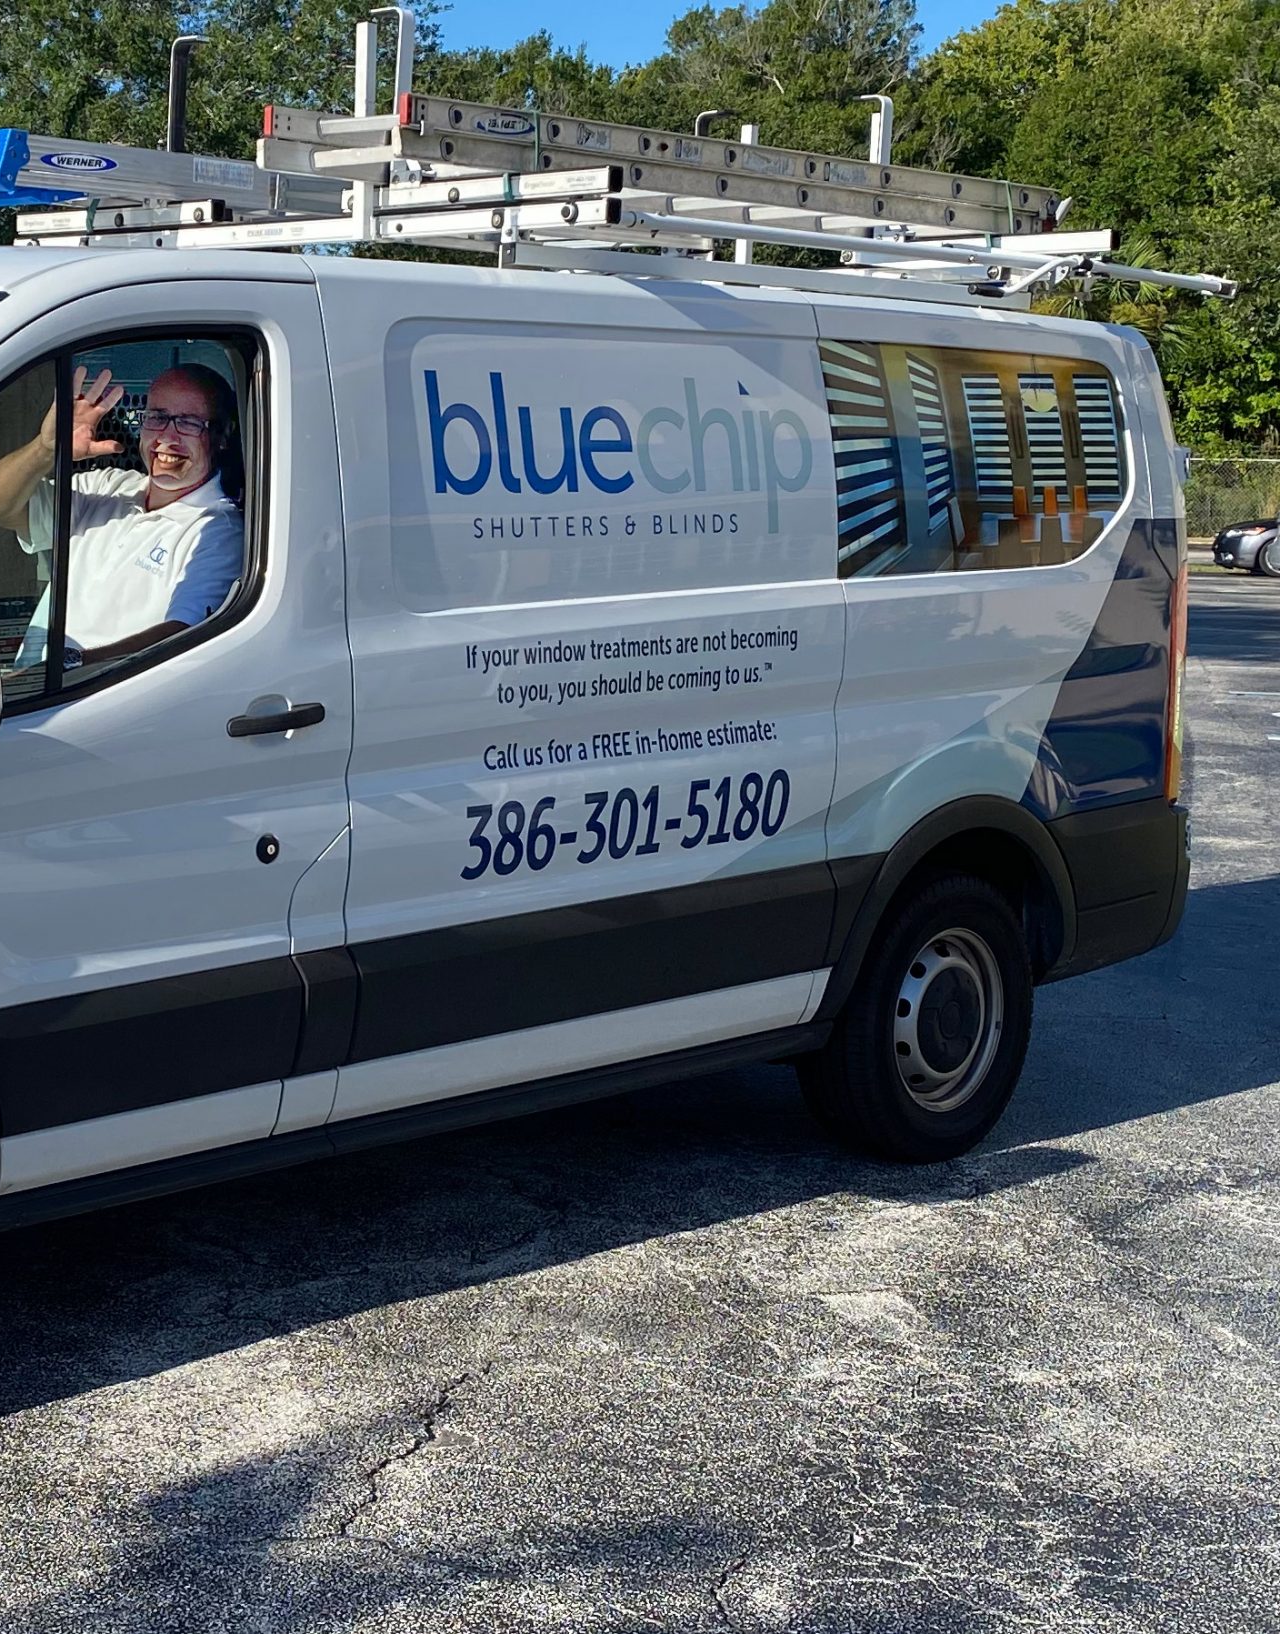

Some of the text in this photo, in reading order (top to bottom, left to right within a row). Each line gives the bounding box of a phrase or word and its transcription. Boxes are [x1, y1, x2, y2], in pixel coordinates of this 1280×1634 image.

[56, 155, 104, 168] WERNER
[473, 513, 739, 539] SHUTTERS & BLINDS
[466, 626, 798, 673] If your window treatments are not becoming
[497, 683, 515, 704] to
[519, 684, 553, 708] you,
[558, 680, 587, 705] you
[591, 671, 641, 697] should
[646, 670, 664, 692] be
[668, 666, 720, 692] coming
[725, 665, 740, 685] to
[483, 720, 777, 770] Call us for a FREE in-home estimate:
[460, 769, 790, 881] 386-301-5180
